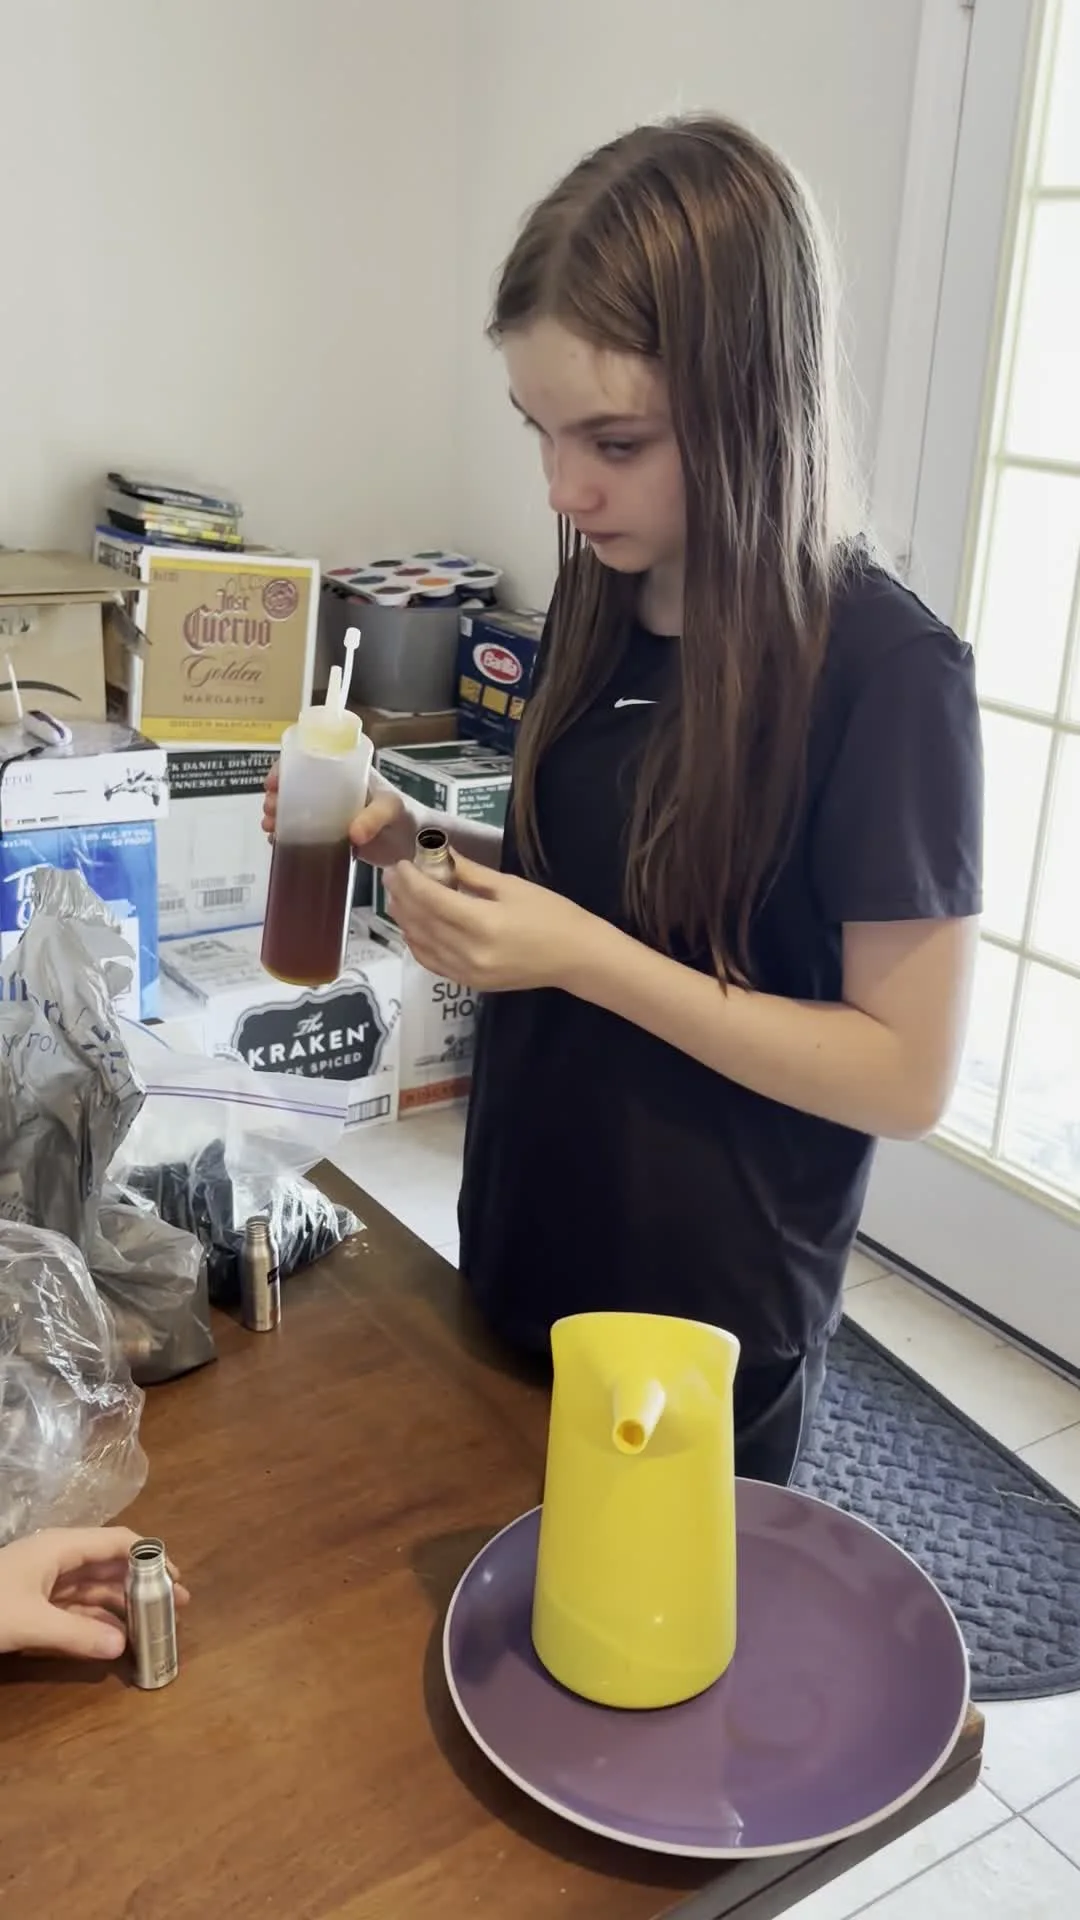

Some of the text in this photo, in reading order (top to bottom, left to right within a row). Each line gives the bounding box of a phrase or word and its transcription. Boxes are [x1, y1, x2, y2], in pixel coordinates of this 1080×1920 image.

[183, 604, 272, 650] Cuervo
[181, 654, 263, 688] Golden
[183, 760, 225, 771] DANIEL
[292, 1011, 324, 1037] The
[248, 1023, 365, 1069] KRAKEN
[310, 1051, 363, 1075] SPICED
